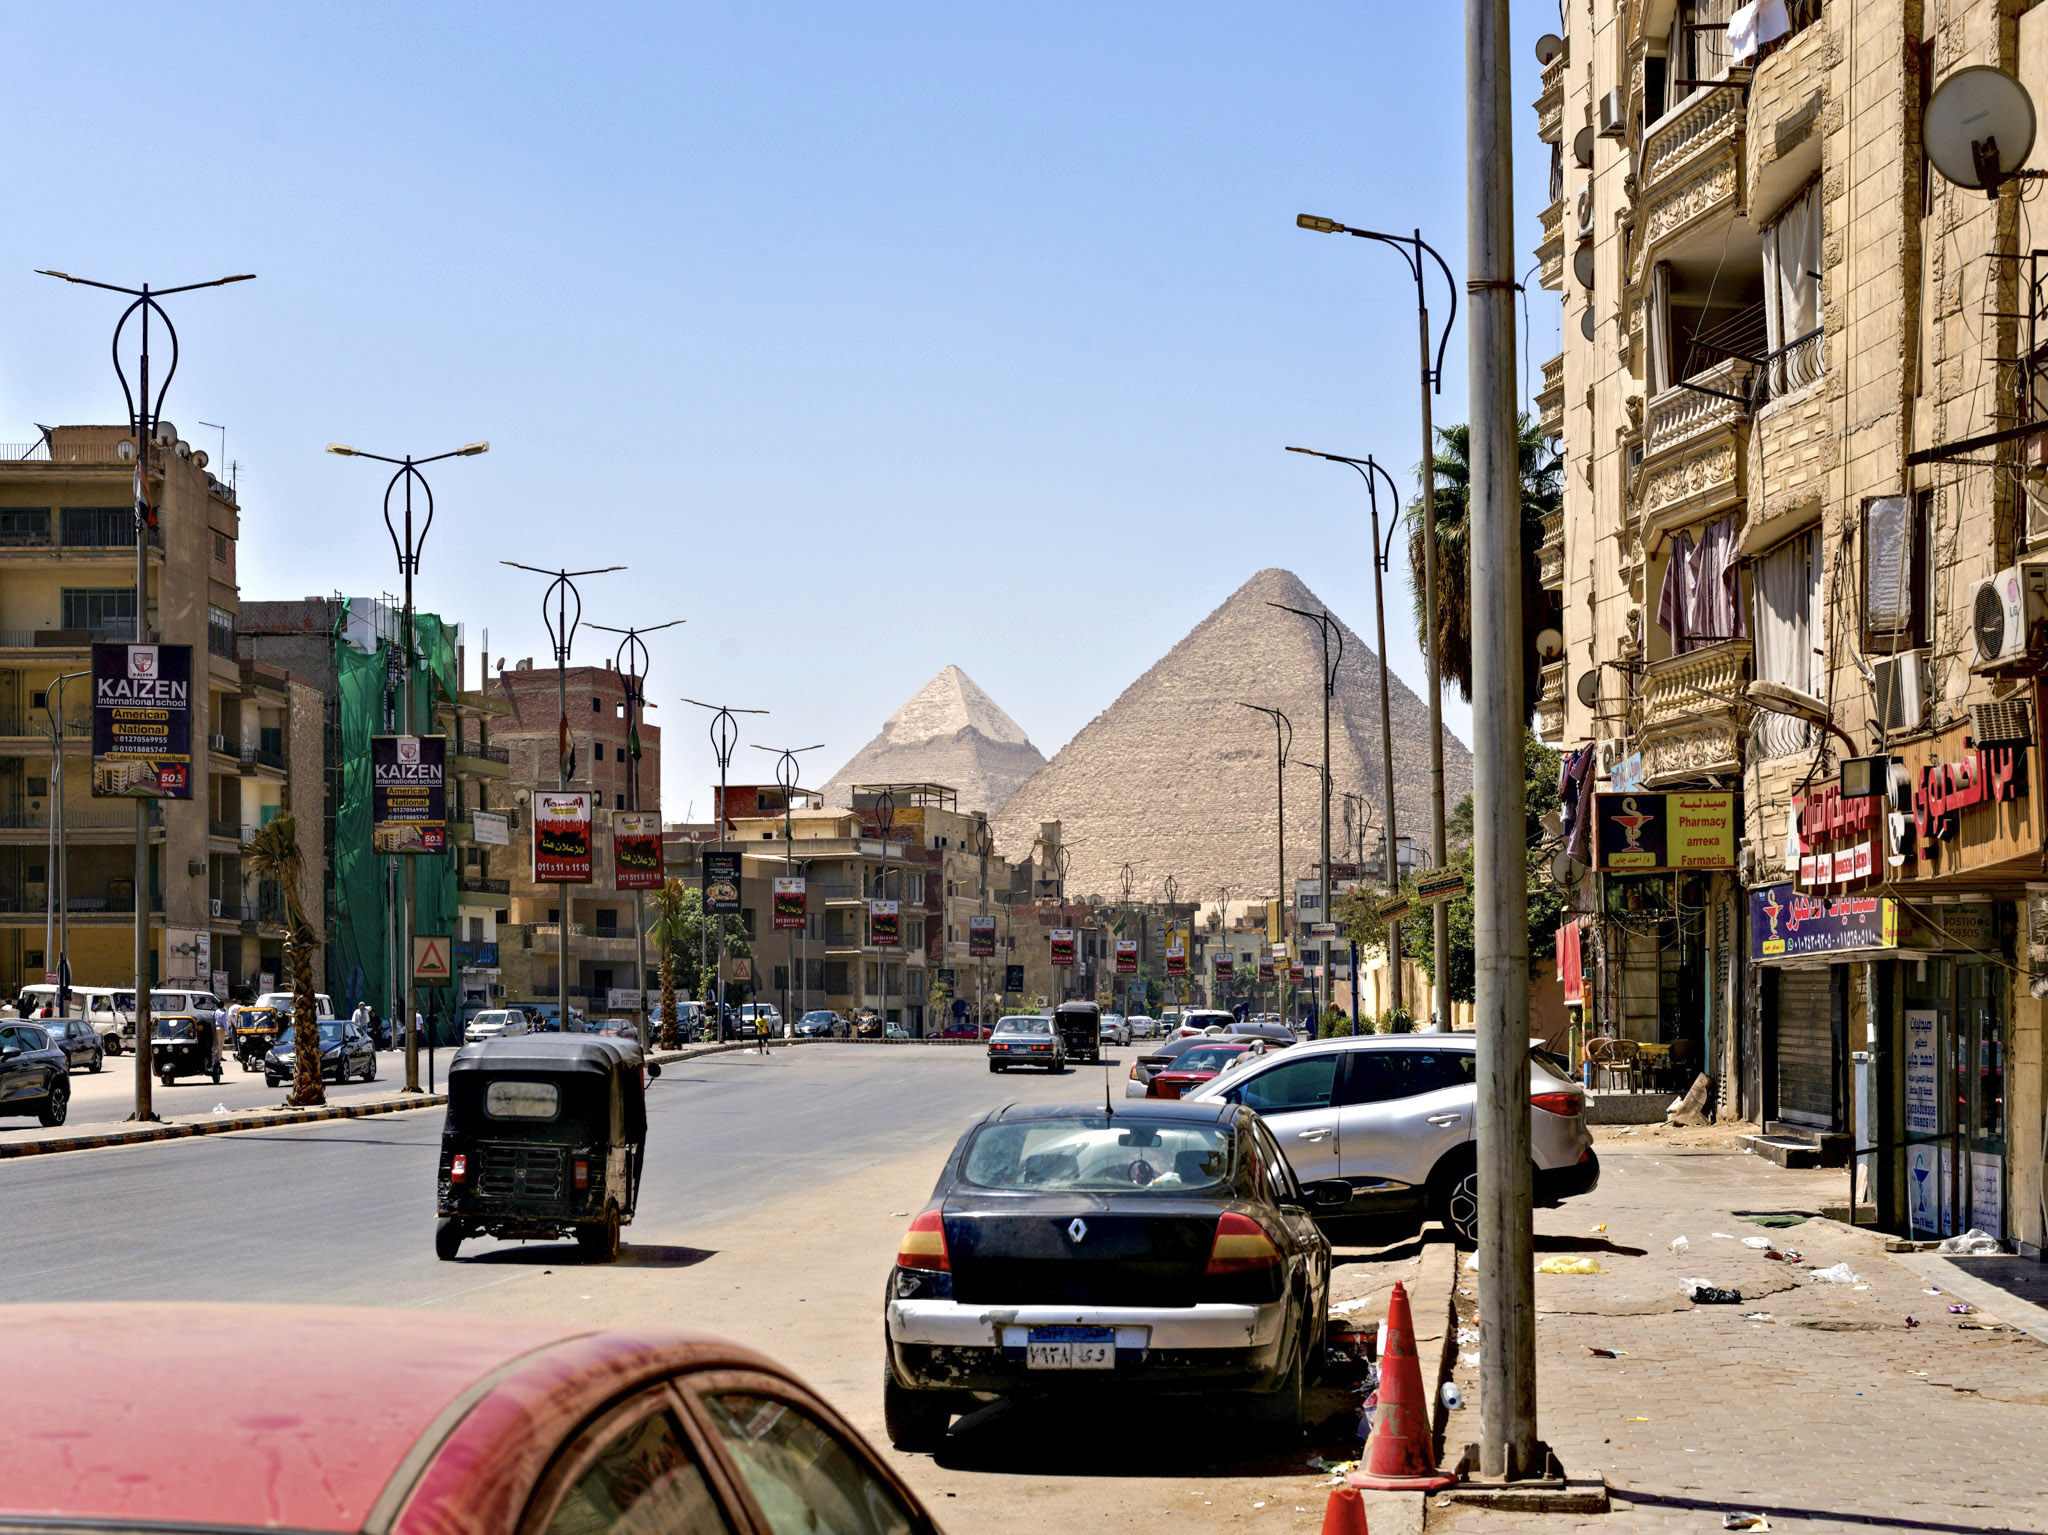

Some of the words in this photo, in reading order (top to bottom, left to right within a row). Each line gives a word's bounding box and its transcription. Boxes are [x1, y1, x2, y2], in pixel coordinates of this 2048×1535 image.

[2010, 605, 2018, 617] LG
[98, 678, 187, 699] KAIZEN
[98, 696, 155, 706] international
[156, 698, 186, 708] school
[114, 710, 167, 720] American
[118, 723, 164, 735] National
[119, 735, 168, 744] 01270569955
[119, 745, 168, 754] 01018885747
[375, 764, 442, 778] KAIZEN
[1990, 747, 2013, 804] بن
[388, 787, 428, 795] American
[392, 798, 427, 806] National
[1679, 796, 1727, 811] صيدلية
[1679, 816, 1727, 828] Pharmacy
[1686, 837, 1720, 847] аптека
[1681, 854, 1726, 866] Farmacia
[538, 862, 550, 872] 011
[556, 862, 564, 872] 11
[572, 862, 579, 872] 11
[582, 863, 590, 872] 10
[1910, 1016, 1932, 1036] صيدليات
